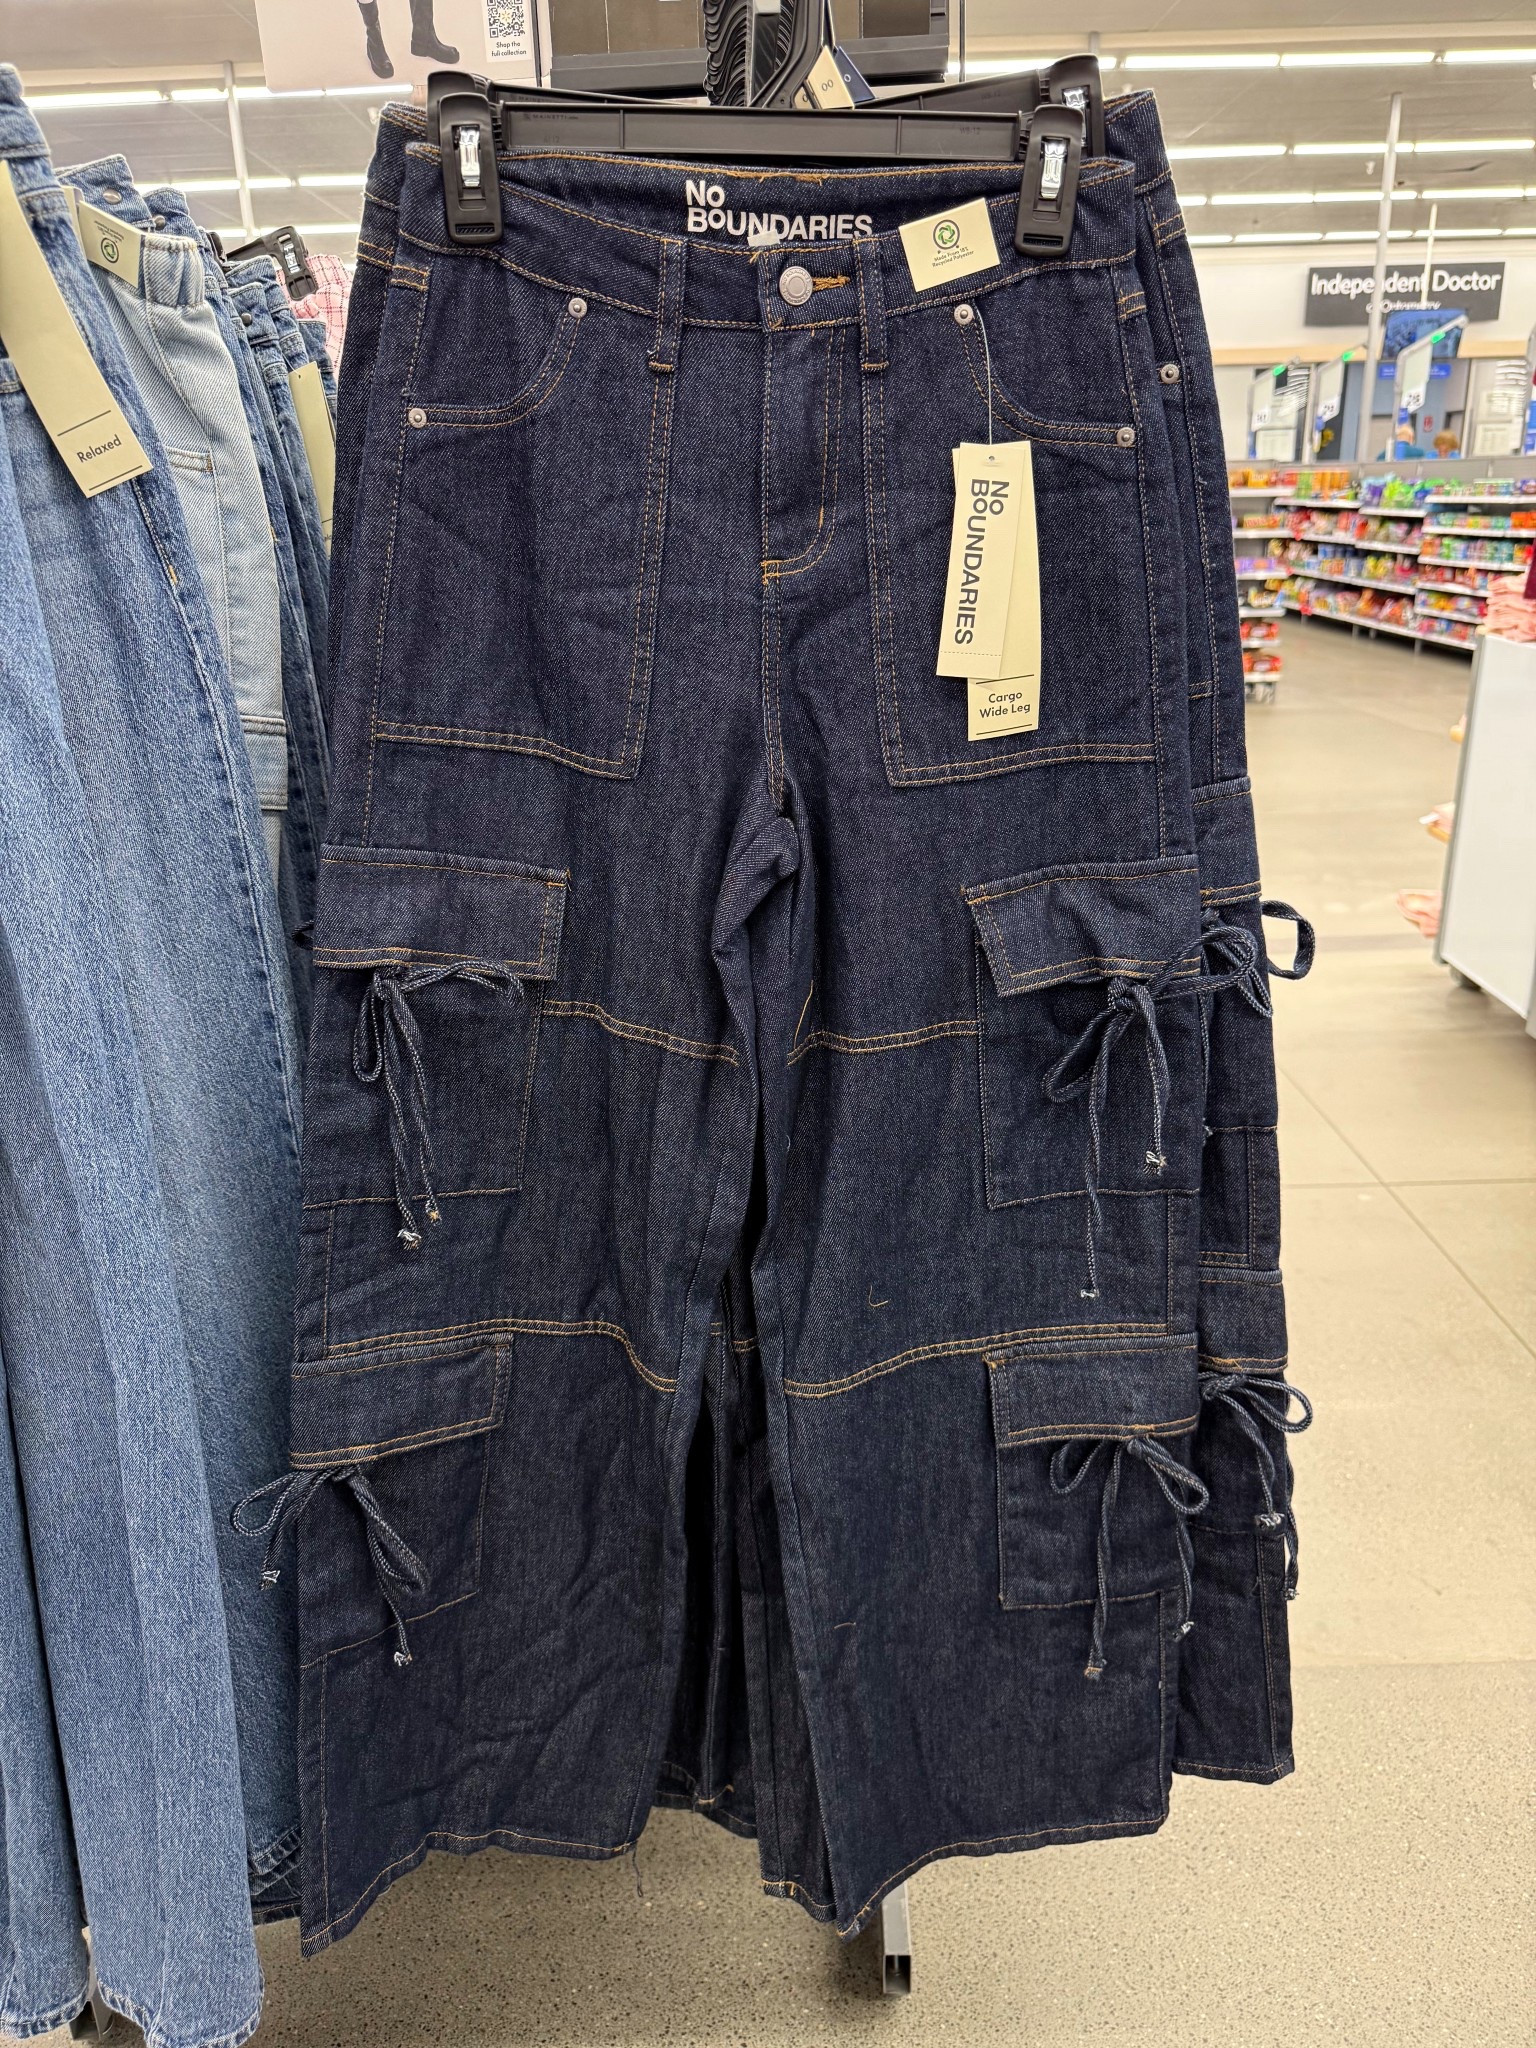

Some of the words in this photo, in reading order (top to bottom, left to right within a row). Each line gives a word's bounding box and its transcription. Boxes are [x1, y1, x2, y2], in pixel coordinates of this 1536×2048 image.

[687, 207, 873, 241] BOUNDARIES
[1311, 271, 1428, 299] Indepedent
[1432, 269, 1501, 292] Doctor
[76, 433, 122, 463] Relaxed
[989, 480, 1010, 515] NO
[954, 478, 990, 645] BOUNDARIES
[979, 705, 1009, 718] Wide
[1011, 703, 1031, 714] Leg
[988, 692, 1023, 703] Cargo
